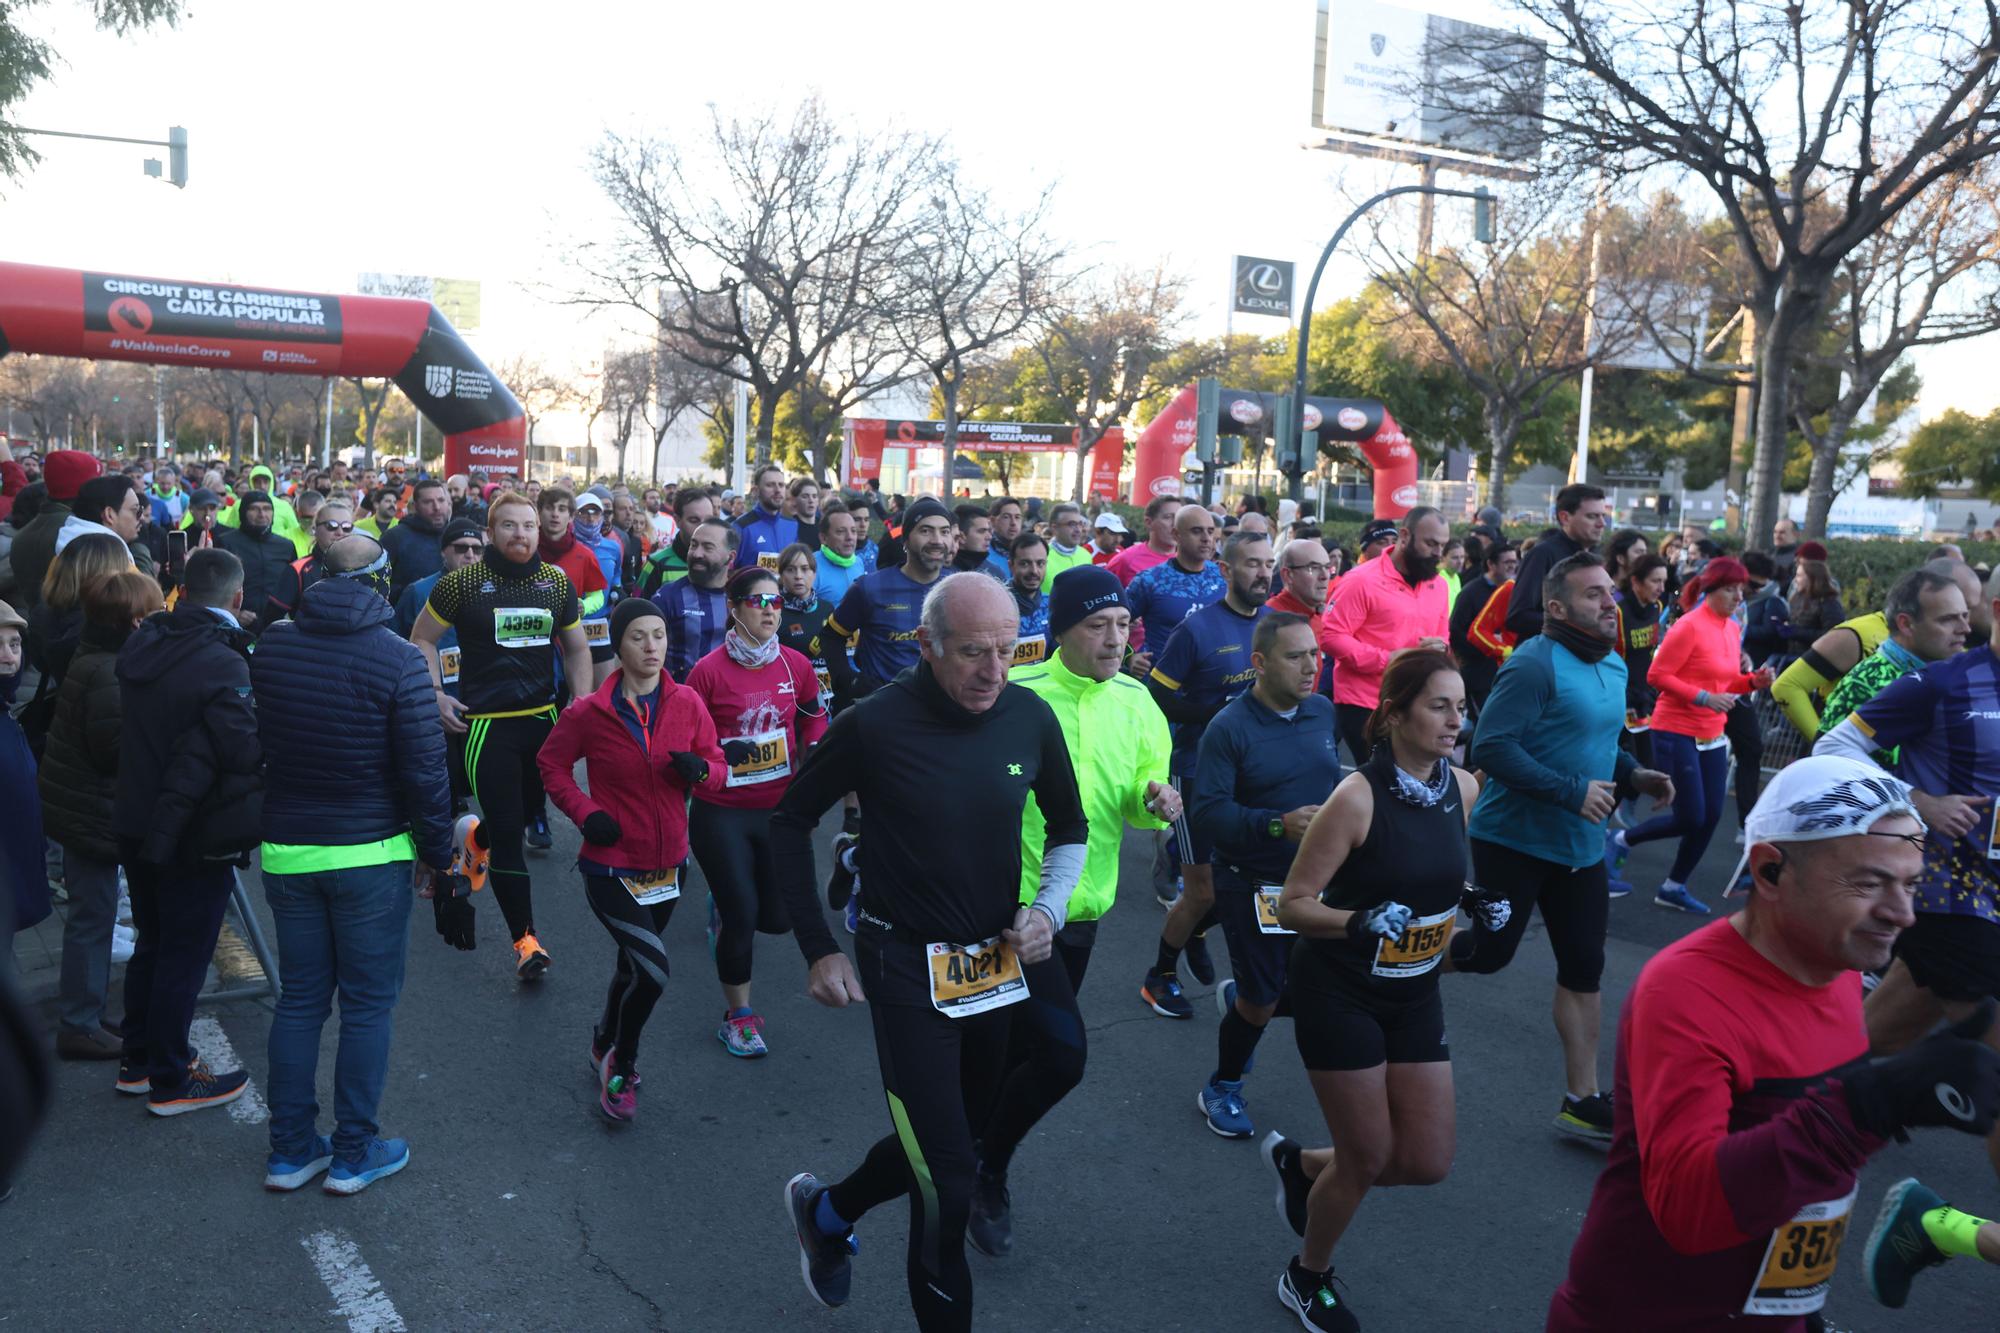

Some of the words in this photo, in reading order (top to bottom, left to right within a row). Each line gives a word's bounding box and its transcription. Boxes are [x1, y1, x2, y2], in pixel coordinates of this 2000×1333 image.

[103, 279, 183, 299] CIRCUIT
[188, 287, 215, 302] DE
[218, 289, 322, 311] CARRERES
[1239, 296, 1289, 311] LEXUS
[109, 339, 231, 359] #ValènciaCorre
[968, 424, 979, 433] DE
[980, 424, 1022, 434] CARRERES
[503, 615, 543, 632] 4395
[1393, 924, 1446, 953] 4155
[946, 947, 1002, 985] 4021
